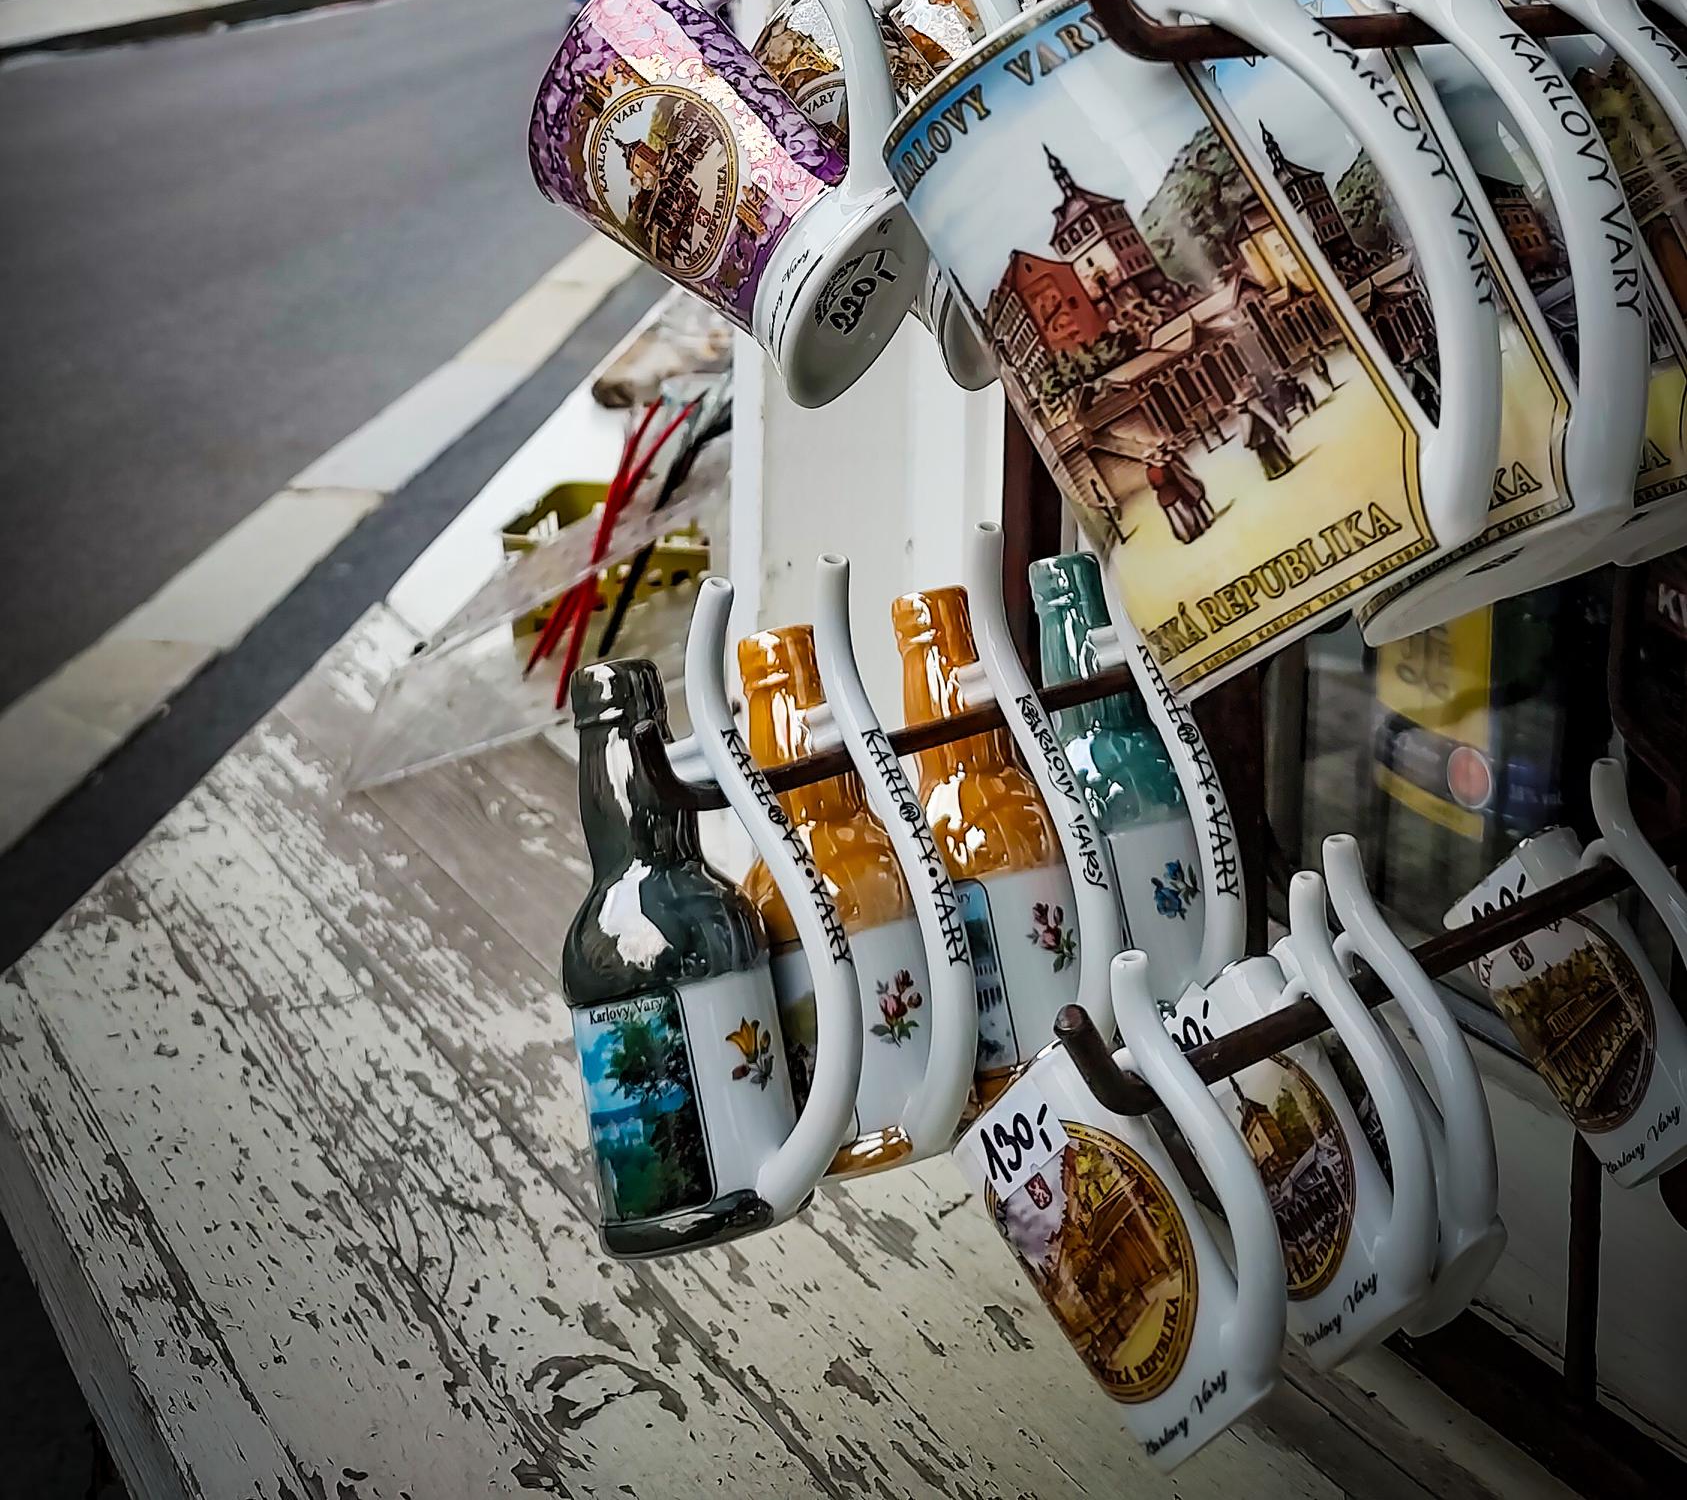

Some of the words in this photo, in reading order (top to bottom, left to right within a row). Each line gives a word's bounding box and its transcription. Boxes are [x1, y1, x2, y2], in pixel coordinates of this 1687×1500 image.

[597, 123, 616, 193] KARLOVY
[613, 100, 645, 124] VARY
[803, 90, 836, 115] VARY
[893, 83, 992, 202] ARLOVY
[1312, 28, 1454, 181] KARLOVY
[1451, 191, 1496, 306] VARY
[1499, 31, 1618, 190] KARLOVY
[1600, 202, 1642, 318] VARY
[1196, 501, 1402, 634] REPUBLIKA
[1256, 603, 1313, 641] KARLOVY
[1319, 582, 1355, 607] VARY
[1360, 538, 1433, 583] KARLSBAD
[720, 727, 815, 867] KARLOVY
[809, 878, 853, 966] VARY
[861, 726, 942, 866] KARLOVY
[928, 874, 970, 967] VARY
[1067, 813, 1109, 891] VARY
[1205, 806, 1241, 901] VARY
[588, 1006, 631, 1025] Karlovy
[633, 998, 665, 1013] Vary
[1646, 1105, 1681, 1142] Vary
[1134, 1296, 1180, 1381] REPUBLIKA
[1343, 1272, 1378, 1313] Vary
[1190, 1369, 1228, 1414] Vary
